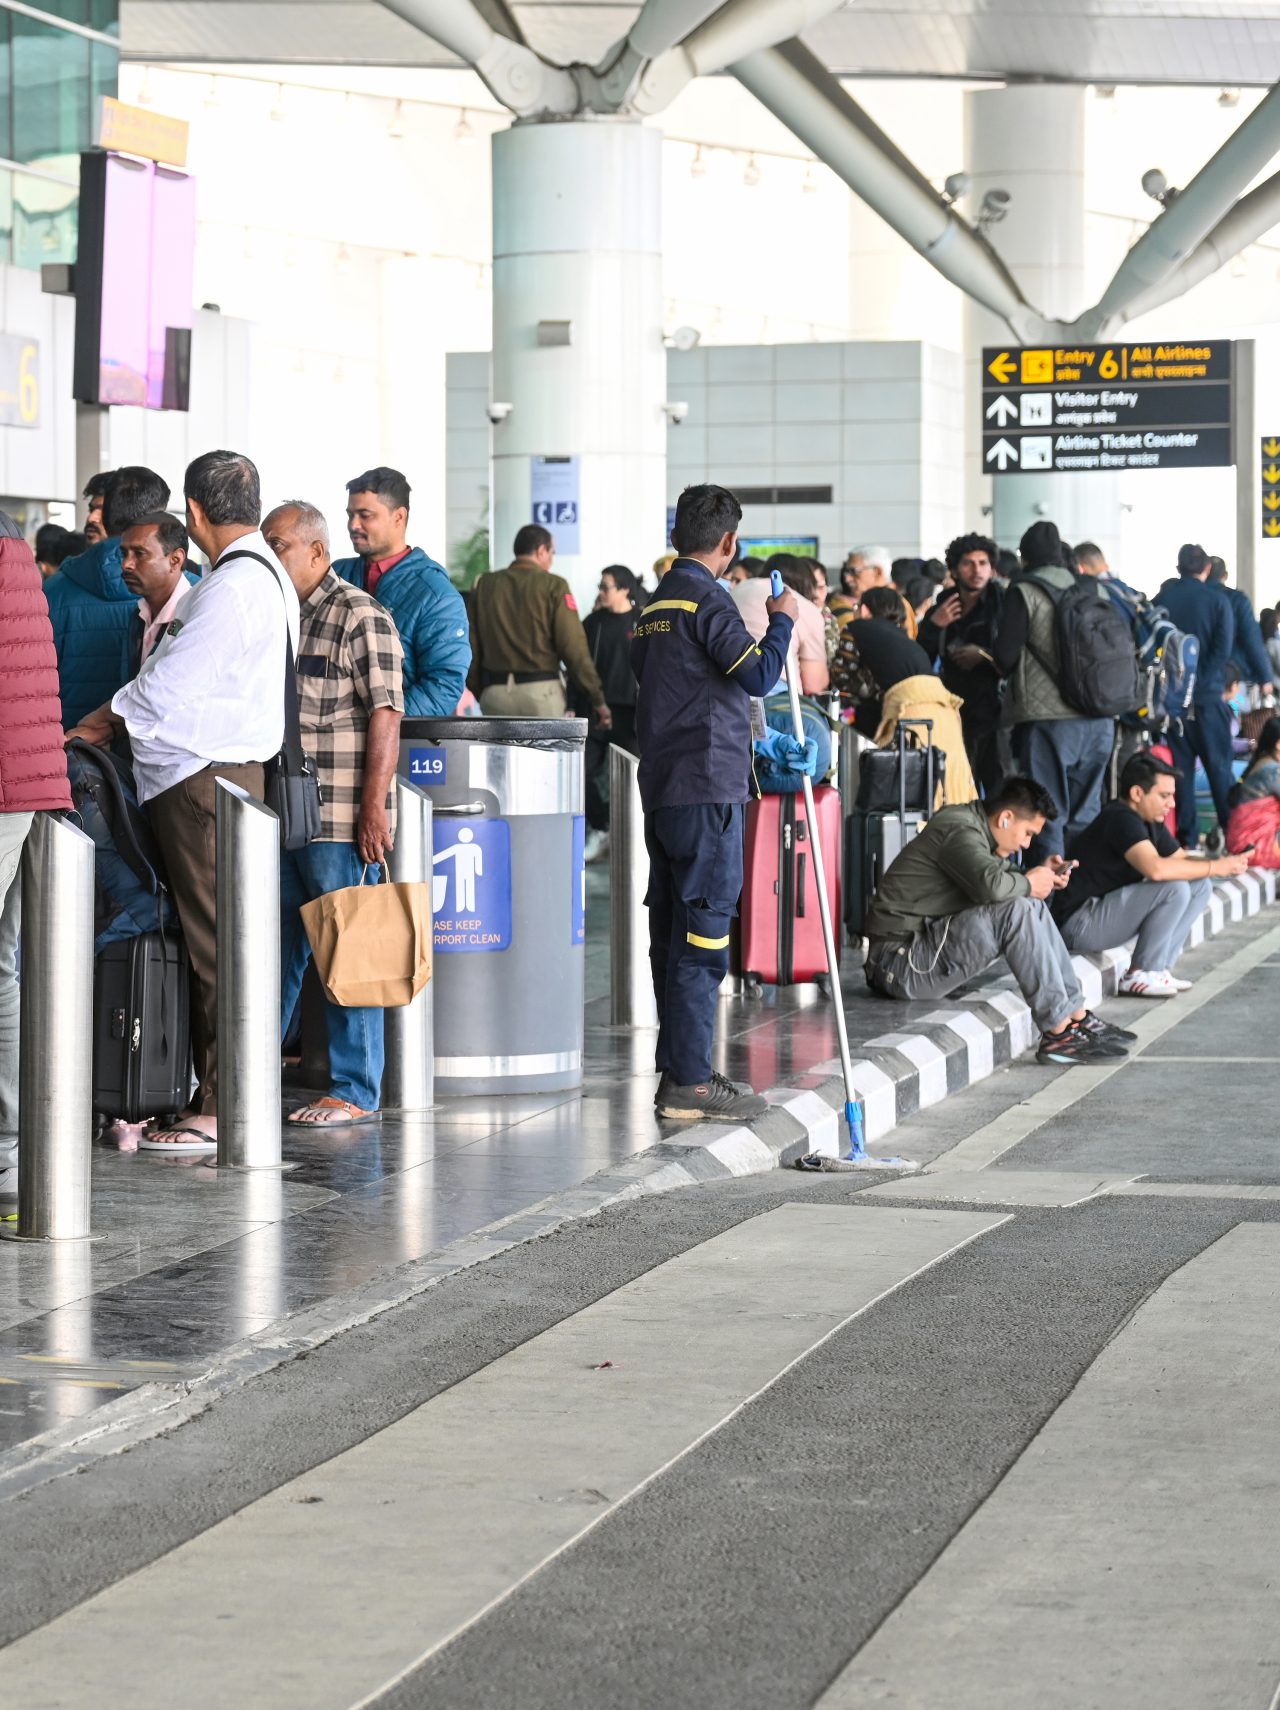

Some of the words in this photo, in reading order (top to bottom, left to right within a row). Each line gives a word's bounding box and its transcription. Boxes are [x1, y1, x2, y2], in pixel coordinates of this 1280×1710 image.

[1131, 346, 1153, 363] All
[1154, 345, 1212, 361] Airlines
[1055, 349, 1095, 367] Entry
[1098, 349, 1119, 380] 6
[1055, 391, 1100, 407] Visitor
[1100, 390, 1139, 409] Entry
[1055, 435, 1100, 451] Airline
[1100, 433, 1143, 449] Ticket
[1143, 432, 1199, 448] Counter
[645, 620, 671, 635] SICES
[411, 759, 443, 774] 119
[433, 921, 453, 931] ASE
[455, 919, 482, 931] KEEP
[434, 934, 467, 945] RPORT
[469, 933, 501, 945] CLEAN
